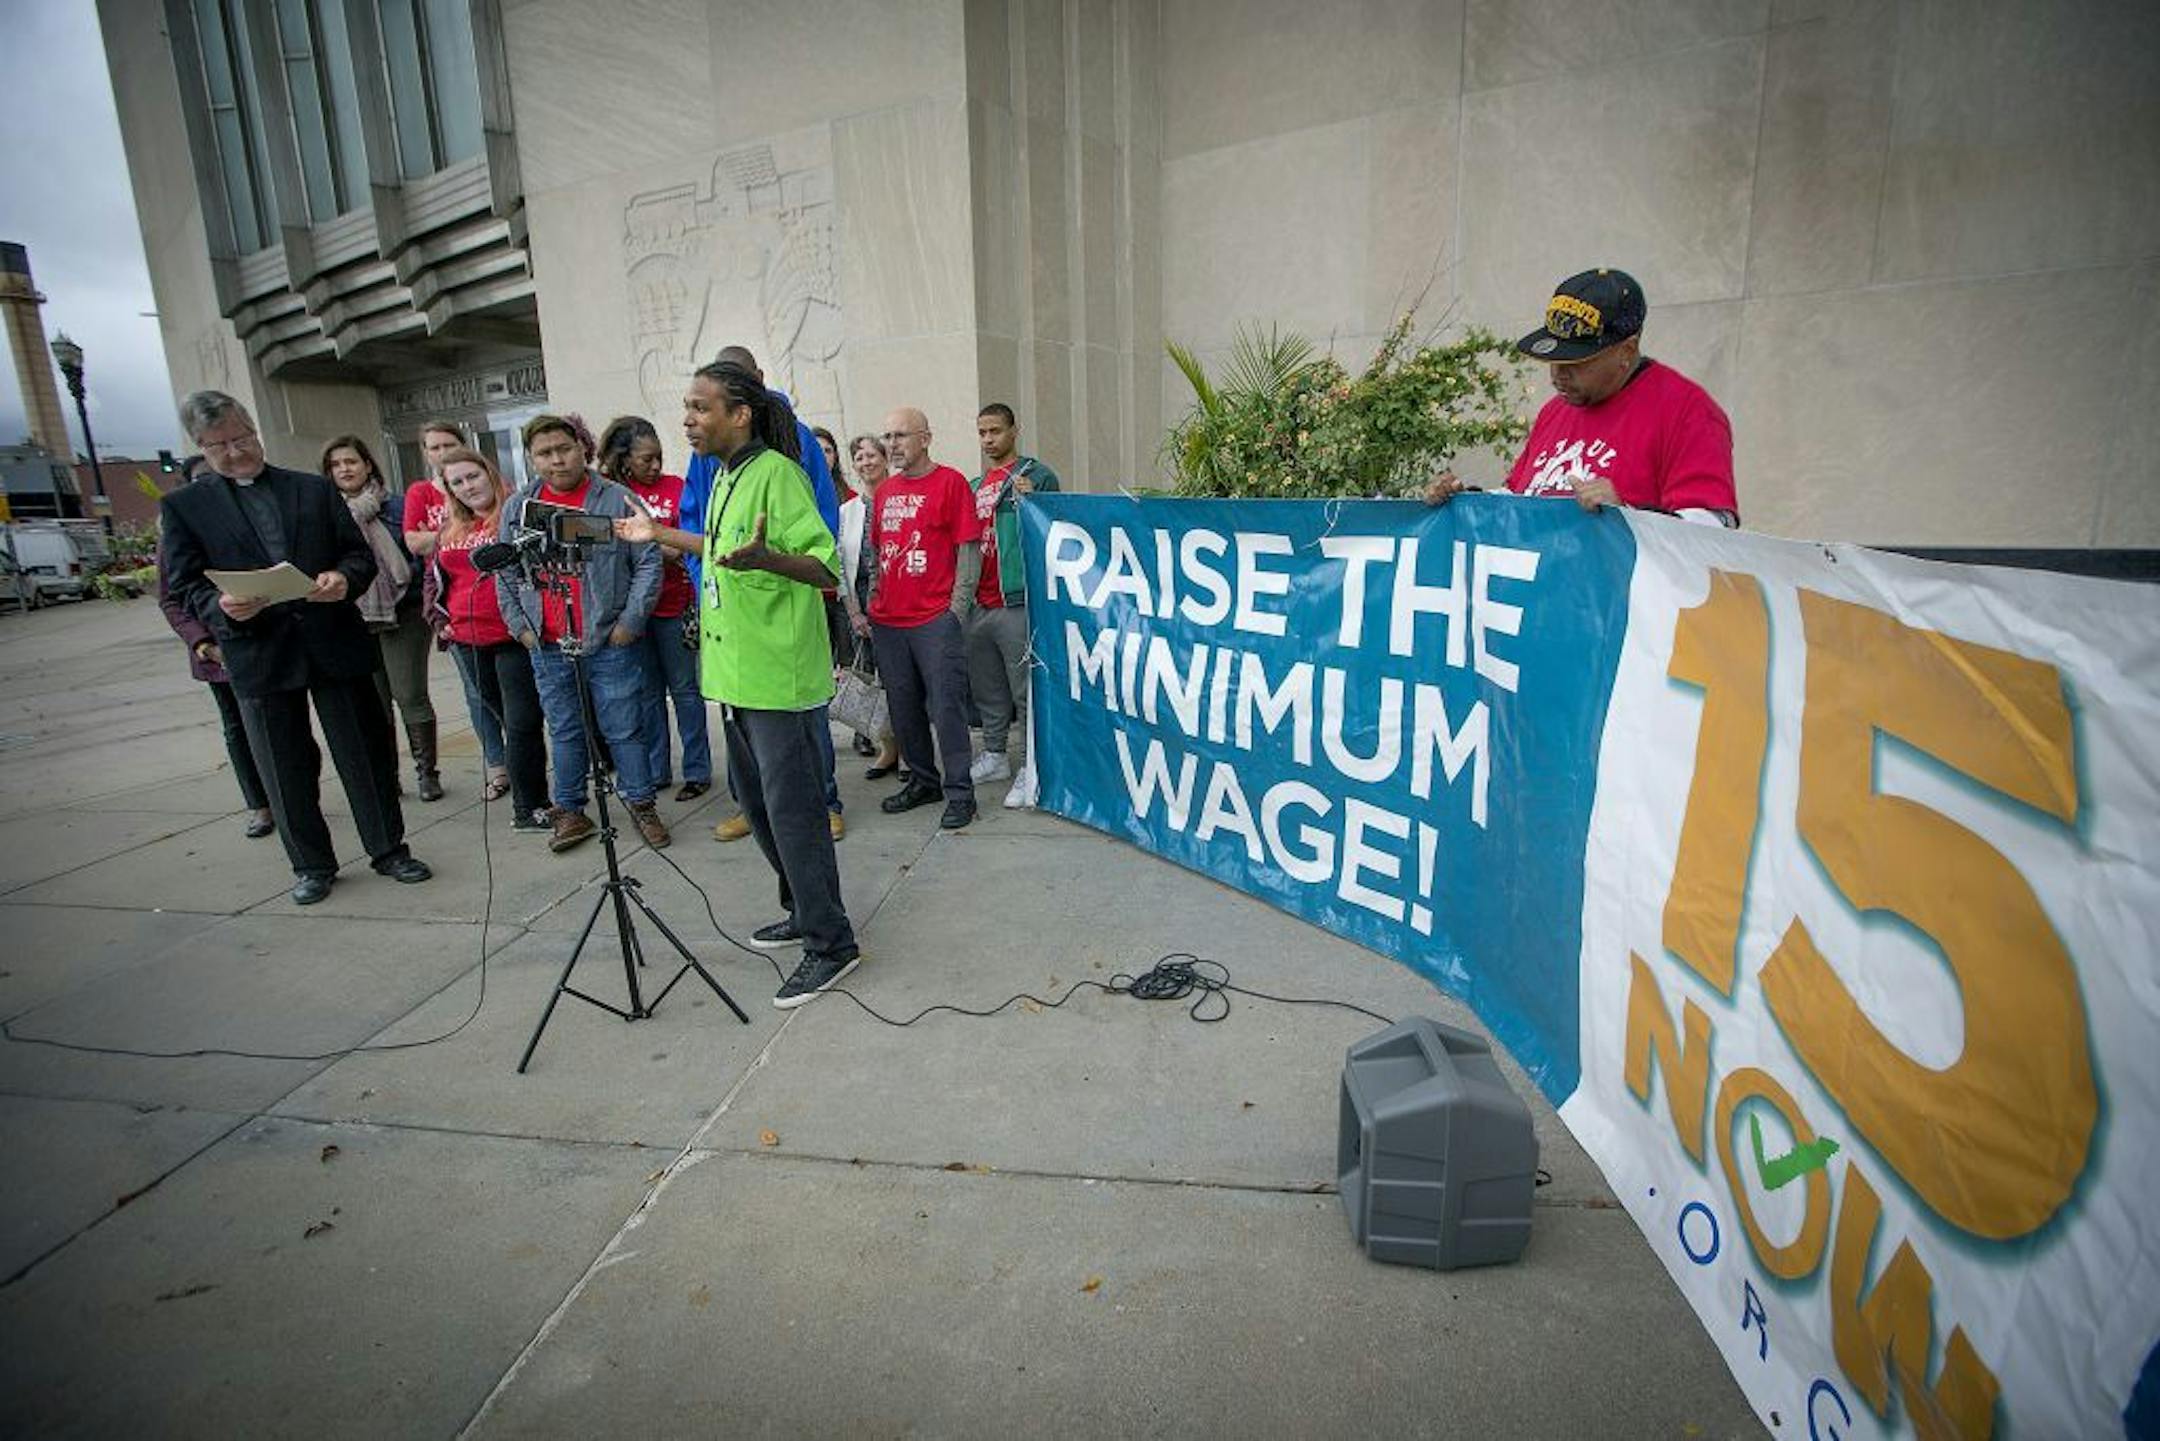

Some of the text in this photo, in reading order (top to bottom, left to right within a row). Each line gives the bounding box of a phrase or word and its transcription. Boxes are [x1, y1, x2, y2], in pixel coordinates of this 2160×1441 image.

[906, 550, 927, 566] 15
[1045, 520, 1541, 693] RAISE THE
[1065, 621, 1490, 830] MINIMUM
[1113, 729, 1439, 936] WAGE!
[1662, 566, 2100, 1242] 15
[1624, 948, 2000, 1441] NOW
